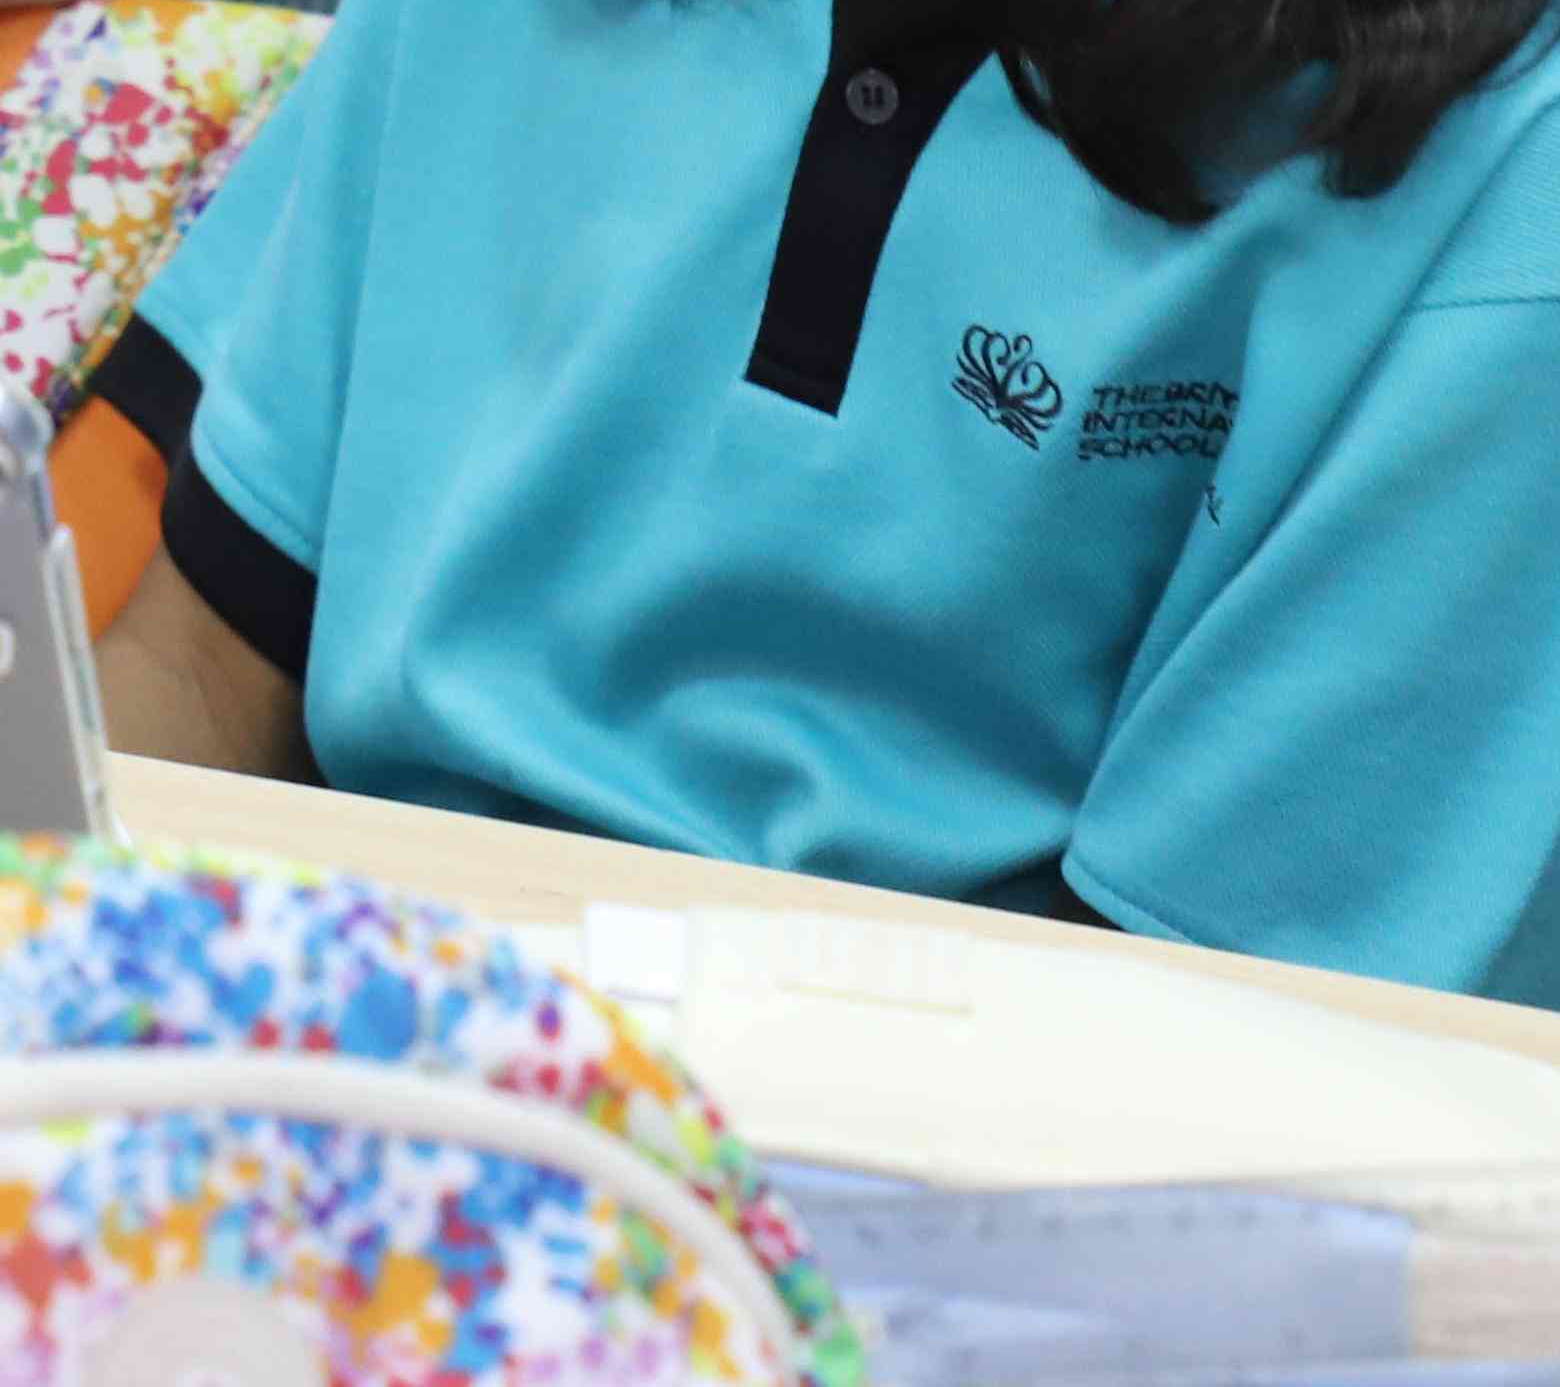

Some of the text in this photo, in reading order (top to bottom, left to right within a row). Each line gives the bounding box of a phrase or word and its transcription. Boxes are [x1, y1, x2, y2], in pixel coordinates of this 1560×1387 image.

[1092, 380, 1240, 410] THE BRIT
[1082, 406, 1235, 434] INTERNA
[1076, 431, 1221, 461] SCHOOL
